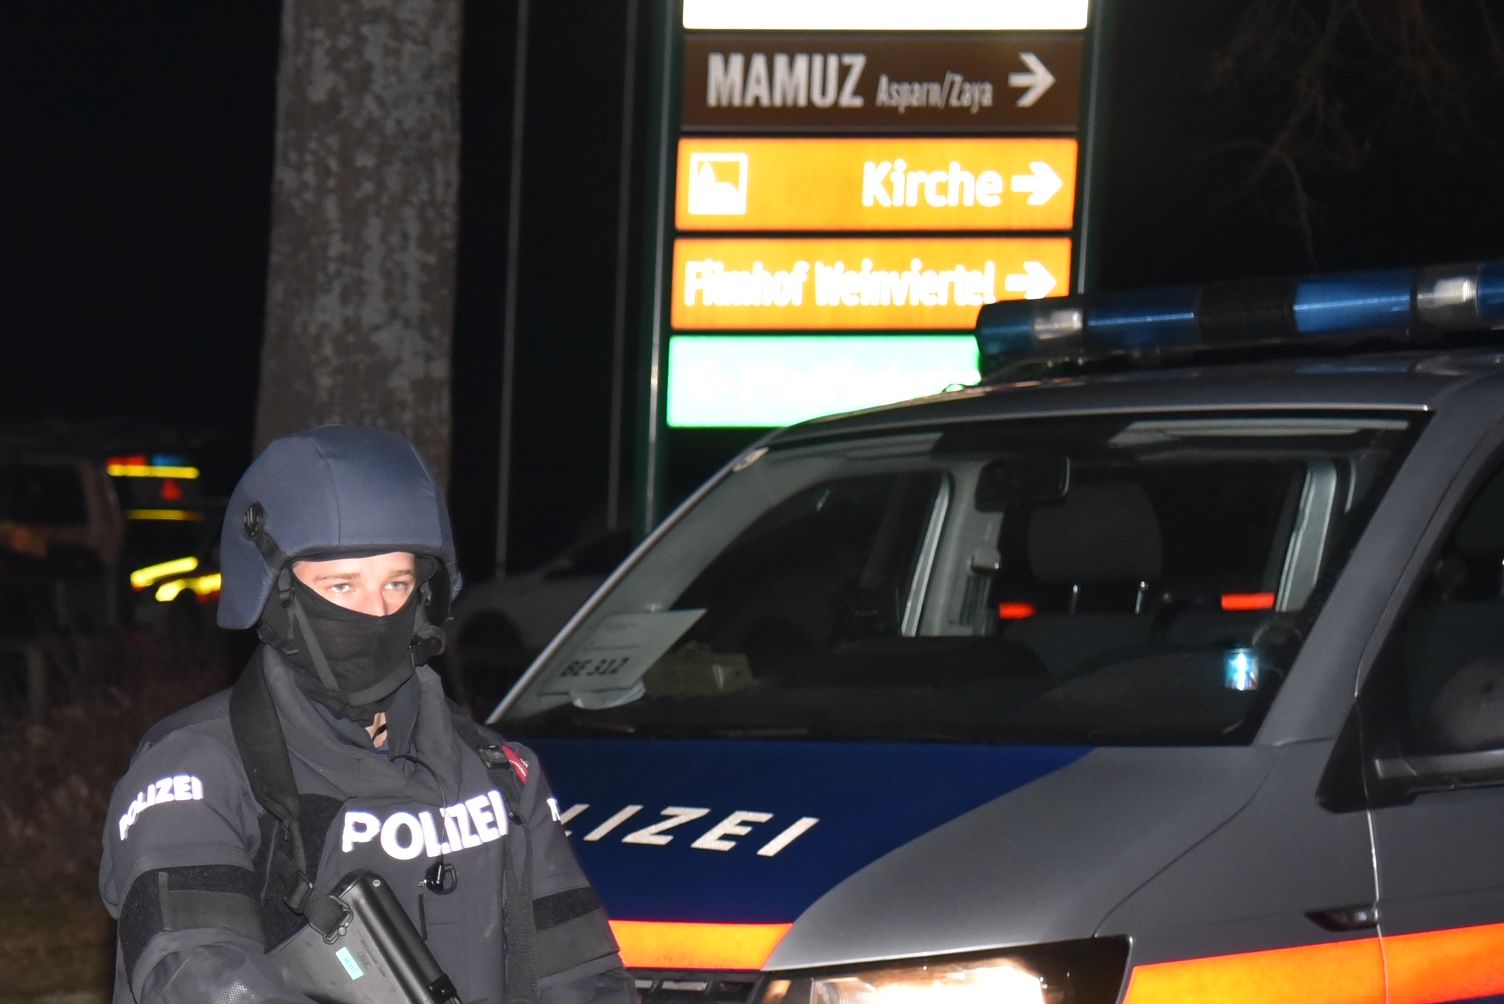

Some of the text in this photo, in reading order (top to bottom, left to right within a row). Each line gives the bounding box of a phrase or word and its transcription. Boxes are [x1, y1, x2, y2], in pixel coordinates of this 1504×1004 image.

[706, 53, 866, 107] MAMUZ
[862, 159, 1004, 208] Kirche
[119, 774, 204, 841] POLIZEI
[341, 789, 509, 860] POLIZEI
